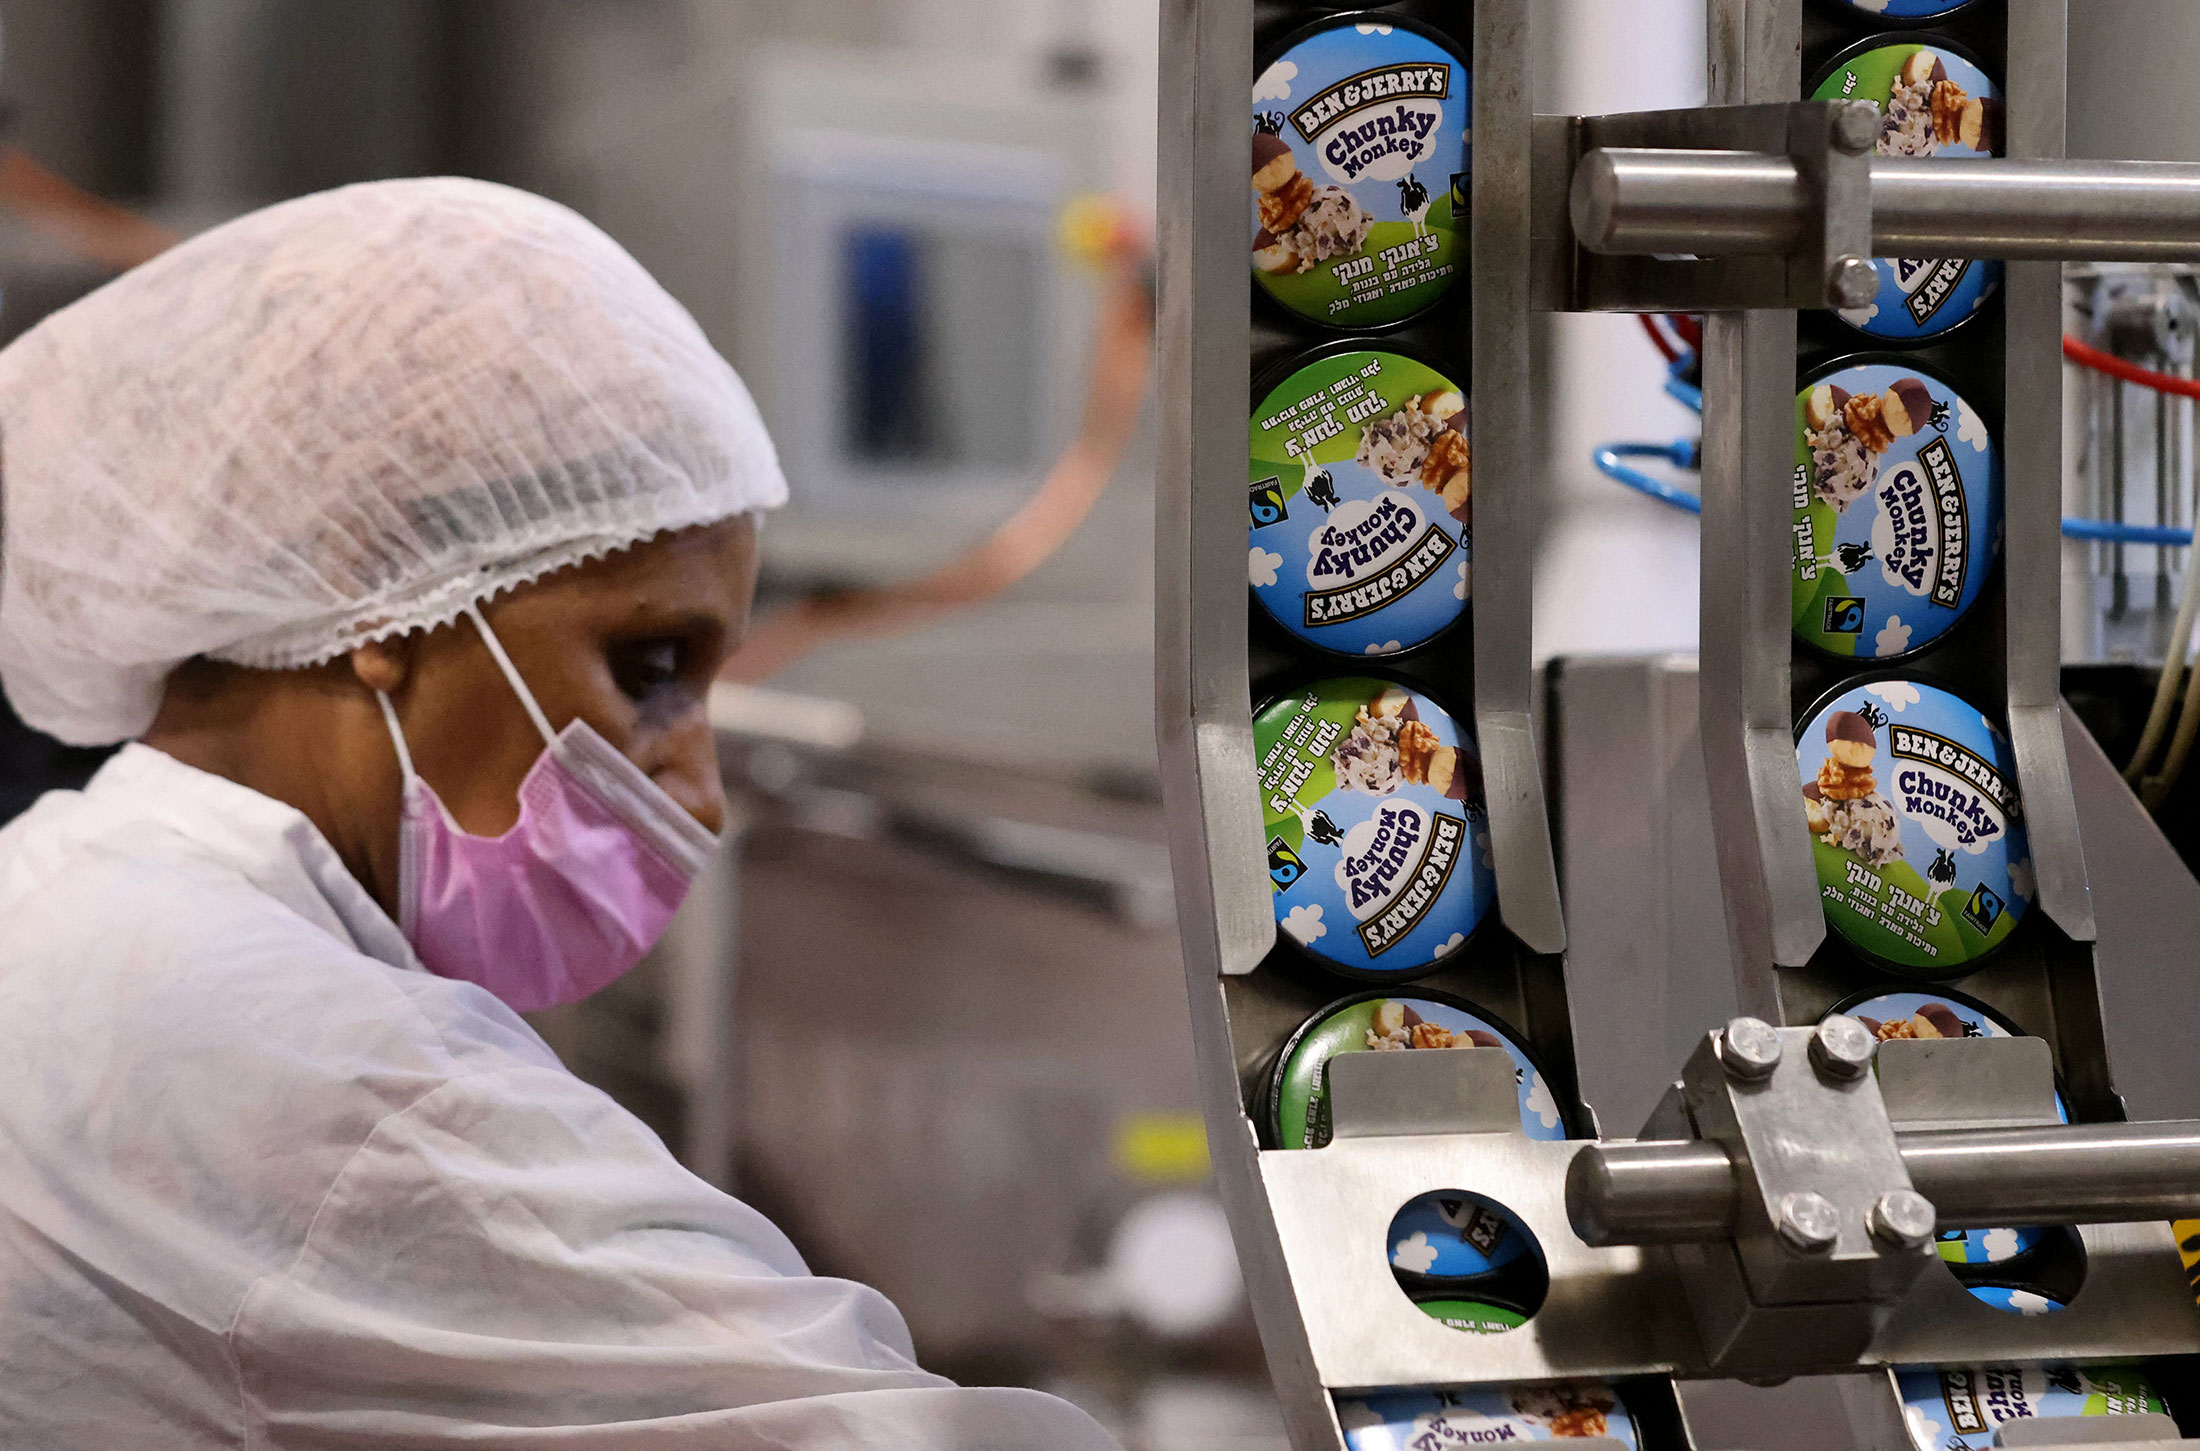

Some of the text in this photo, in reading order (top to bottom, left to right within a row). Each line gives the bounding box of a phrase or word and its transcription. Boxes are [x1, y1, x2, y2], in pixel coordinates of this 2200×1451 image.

[1325, 106, 1436, 165] Chunky
[1342, 136, 1424, 179] Monkey
[1332, 256, 1375, 286] מנקי
[1382, 269, 1398, 282] עם
[1328, 299, 1350, 315] מלך
[1360, 358, 1382, 378] מלך
[1320, 400, 1336, 416] עם
[1346, 390, 1388, 424] מנקי
[1250, 479, 1278, 493] FAIRTRAD
[1321, 496, 1397, 547] Monkey
[1879, 486, 1911, 574] Monkey
[1893, 469, 1934, 590] Chunky
[1313, 506, 1417, 577] Chunky
[1283, 746, 1298, 763] עם
[1307, 718, 1342, 758] מנקי
[1899, 771, 2000, 837] Chunky
[1905, 797, 1976, 845] Monkey
[1346, 807, 1396, 877] Monkey
[1350, 809, 1421, 908] Chunky
[1822, 885, 1844, 903] מלך
[1845, 860, 1882, 893] מנקי
[1881, 902, 1896, 917] עם
